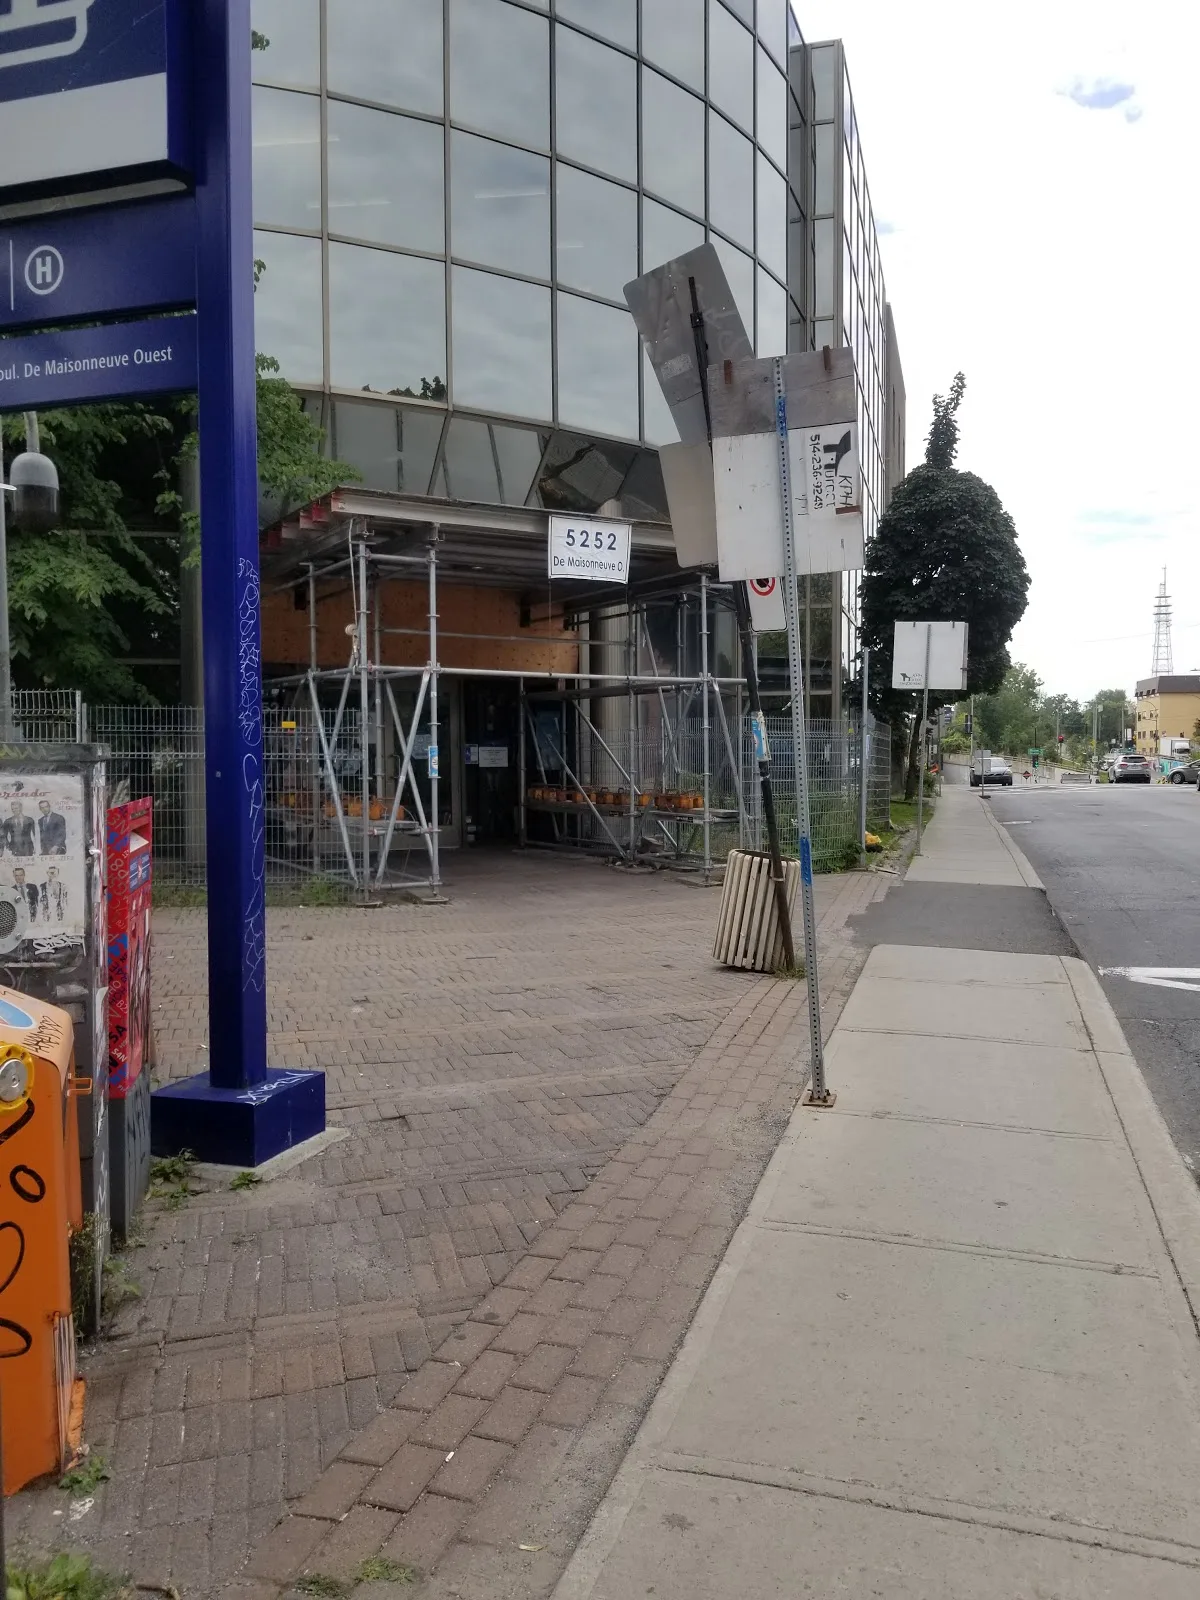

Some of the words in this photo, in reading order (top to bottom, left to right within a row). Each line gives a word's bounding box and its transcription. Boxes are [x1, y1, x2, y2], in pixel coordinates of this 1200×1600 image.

[24, 362, 41, 378] De
[45, 353, 129, 376] Maisonneuve
[133, 345, 173, 365] Ouest
[838, 474, 854, 507] KPH
[565, 528, 617, 551] 5252
[553, 555, 566, 567] De
[567, 556, 616, 571] Maisonneuve
